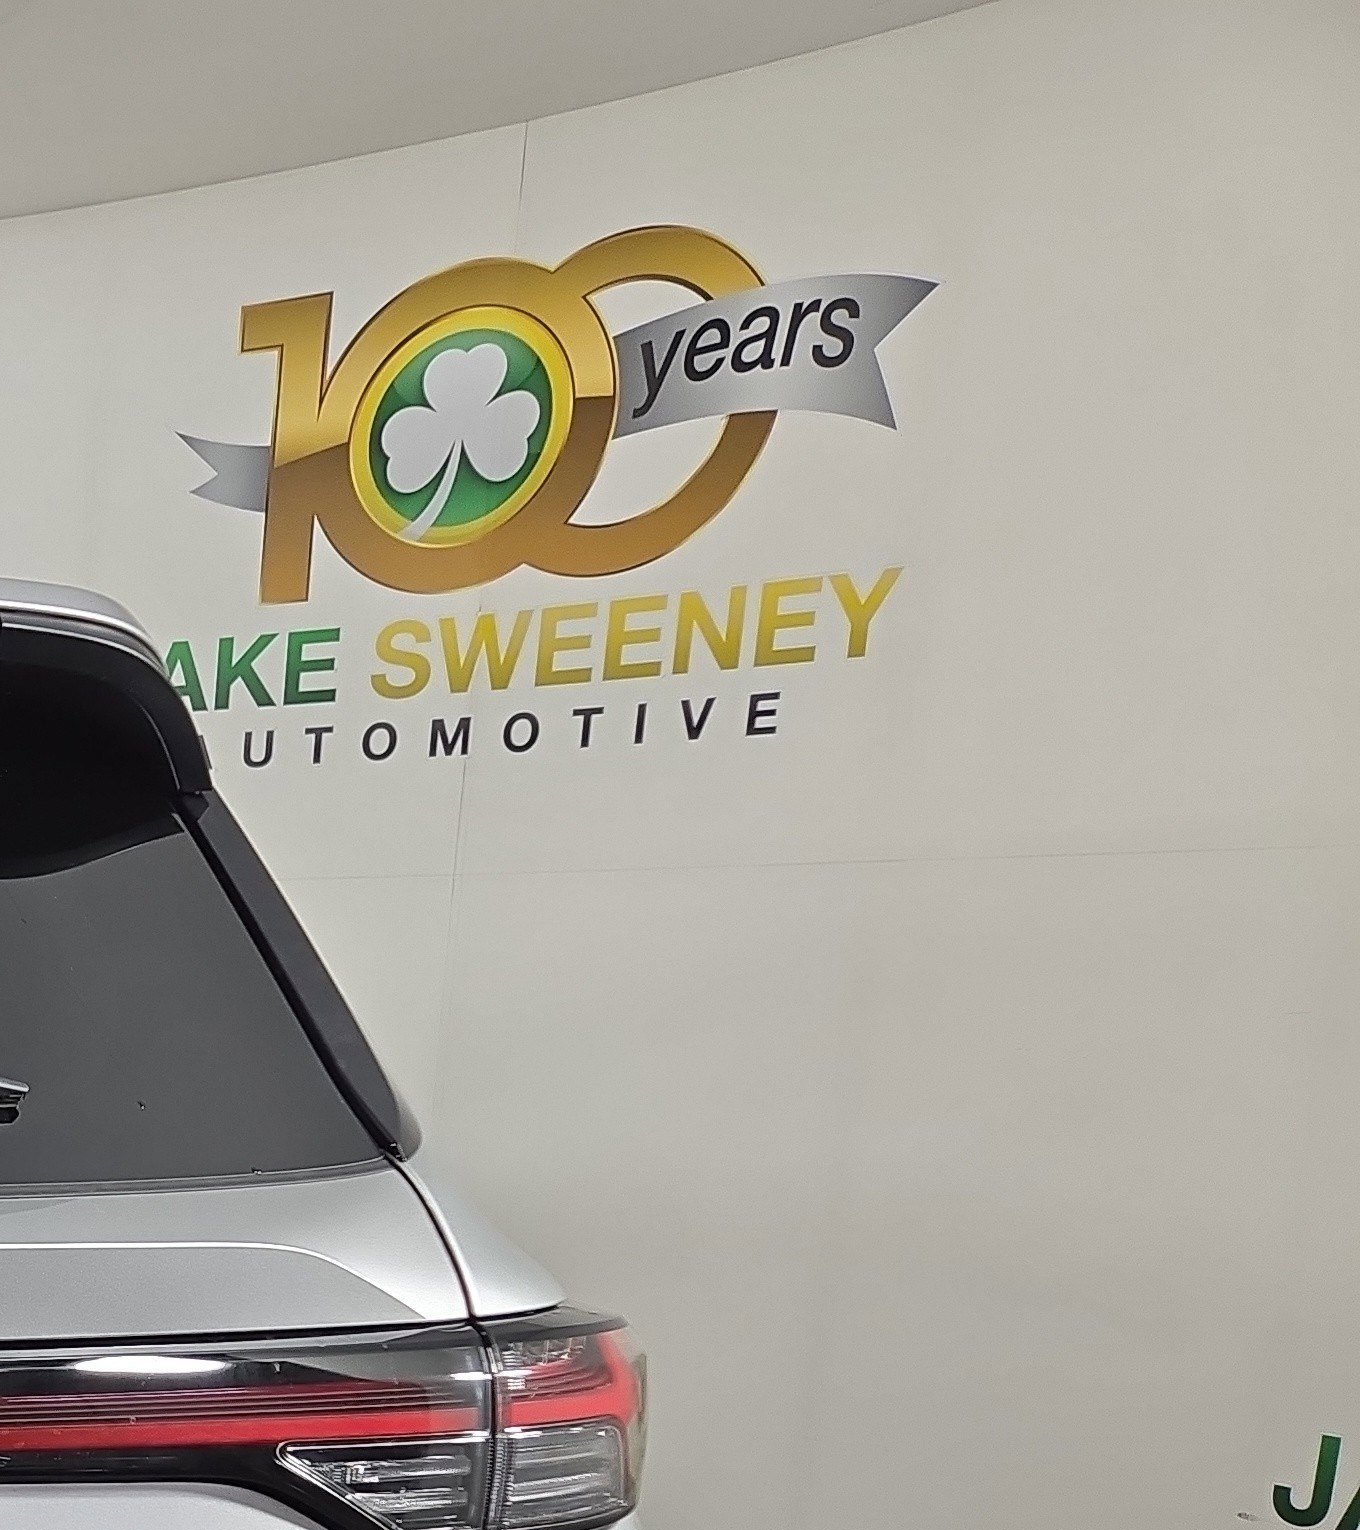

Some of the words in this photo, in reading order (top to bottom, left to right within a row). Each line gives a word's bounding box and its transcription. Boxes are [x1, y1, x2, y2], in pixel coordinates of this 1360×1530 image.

[239, 224, 778, 604] 100
[632, 294, 861, 419] years
[369, 566, 905, 701] SWEENEY
[198, 690, 784, 769] UTOMOTIVE
